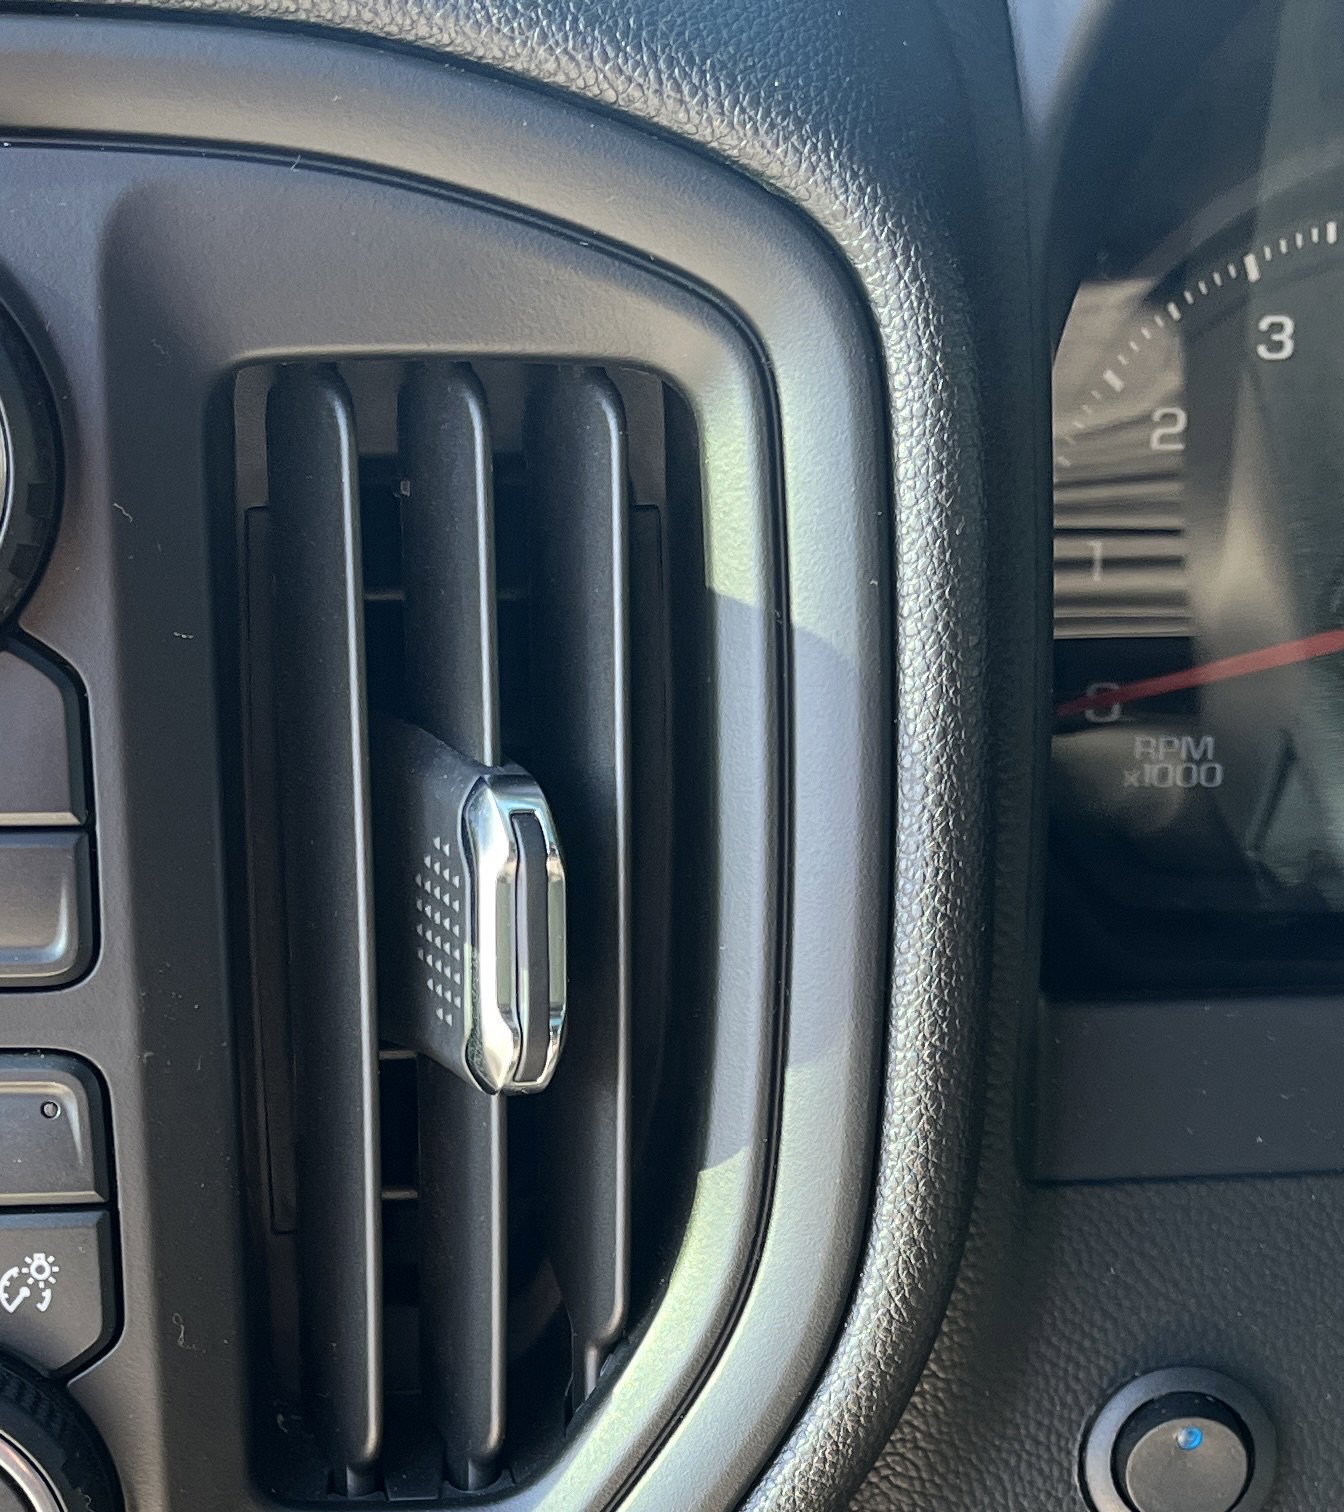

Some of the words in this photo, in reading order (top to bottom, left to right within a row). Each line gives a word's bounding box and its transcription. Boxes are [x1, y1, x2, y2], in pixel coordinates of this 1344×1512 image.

[1257, 315, 1295, 360] 3
[1150, 407, 1187, 451] 2
[1086, 540, 1103, 581] 1
[1133, 735, 1216, 760] RPM
